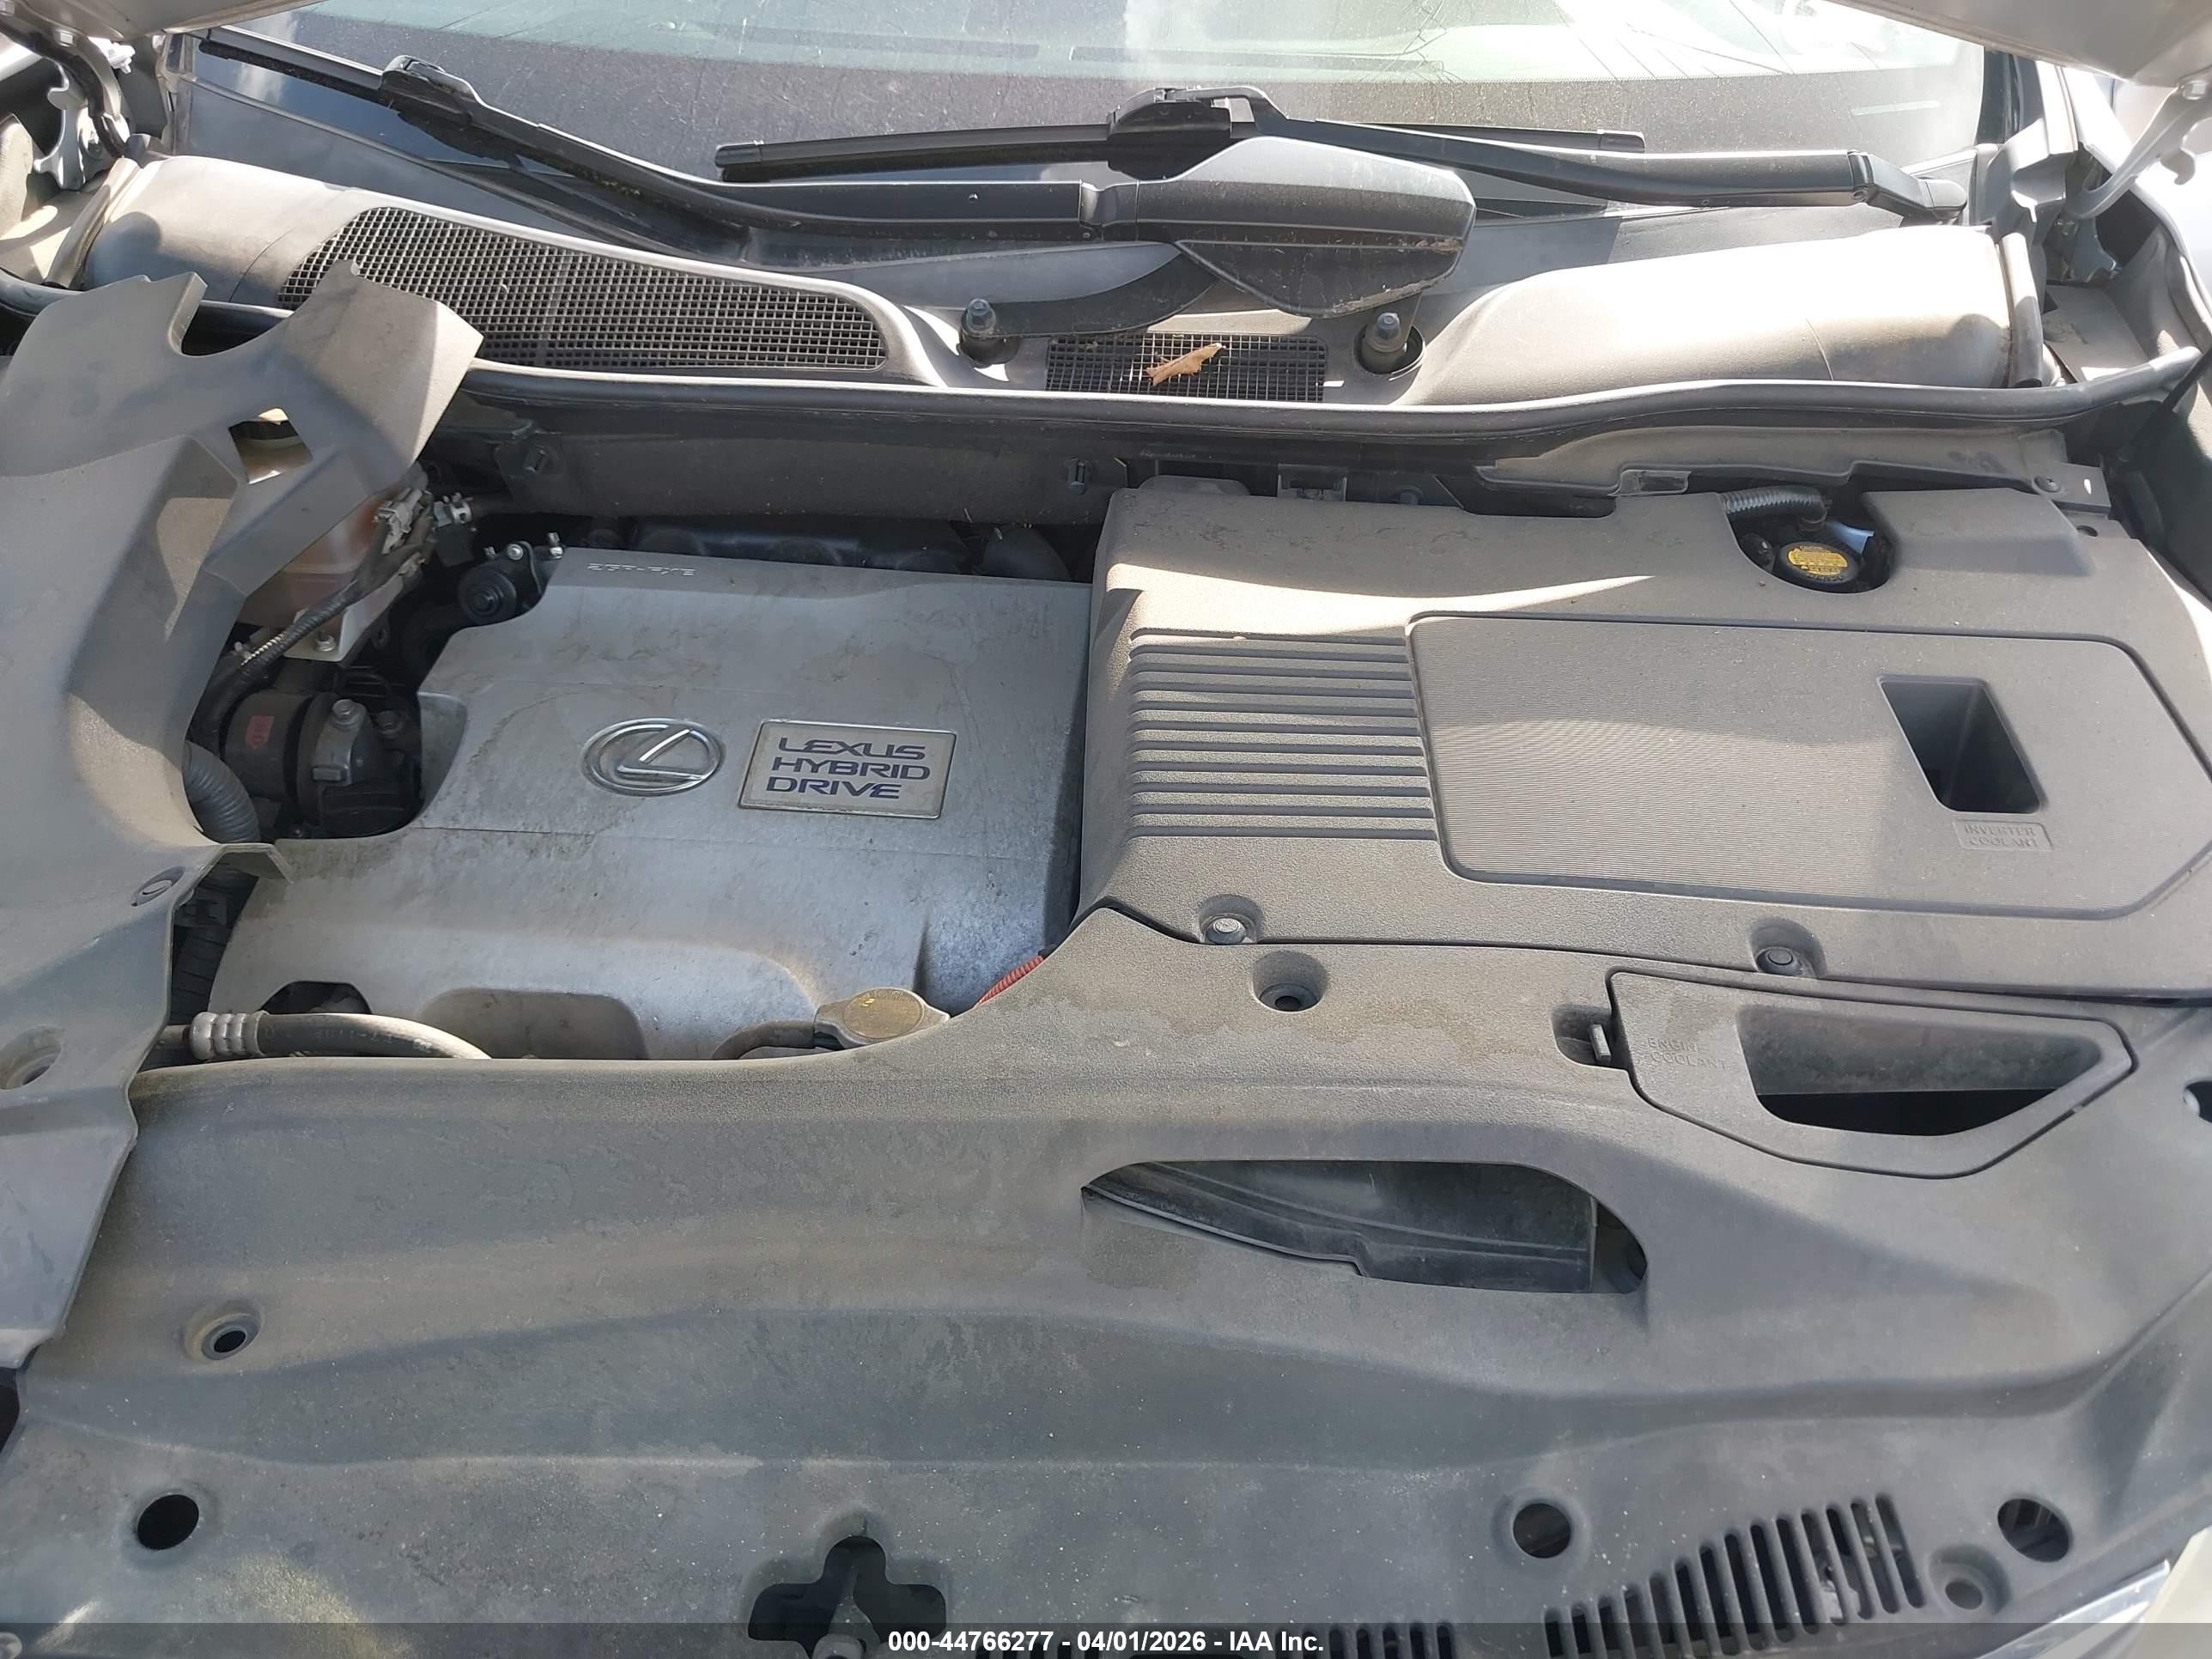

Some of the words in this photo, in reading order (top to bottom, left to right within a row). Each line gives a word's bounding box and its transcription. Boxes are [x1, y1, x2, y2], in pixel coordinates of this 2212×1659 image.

[778, 737, 926, 761] LEXUS
[772, 757, 931, 781] HYBRID
[766, 776, 902, 799] DRIVE
